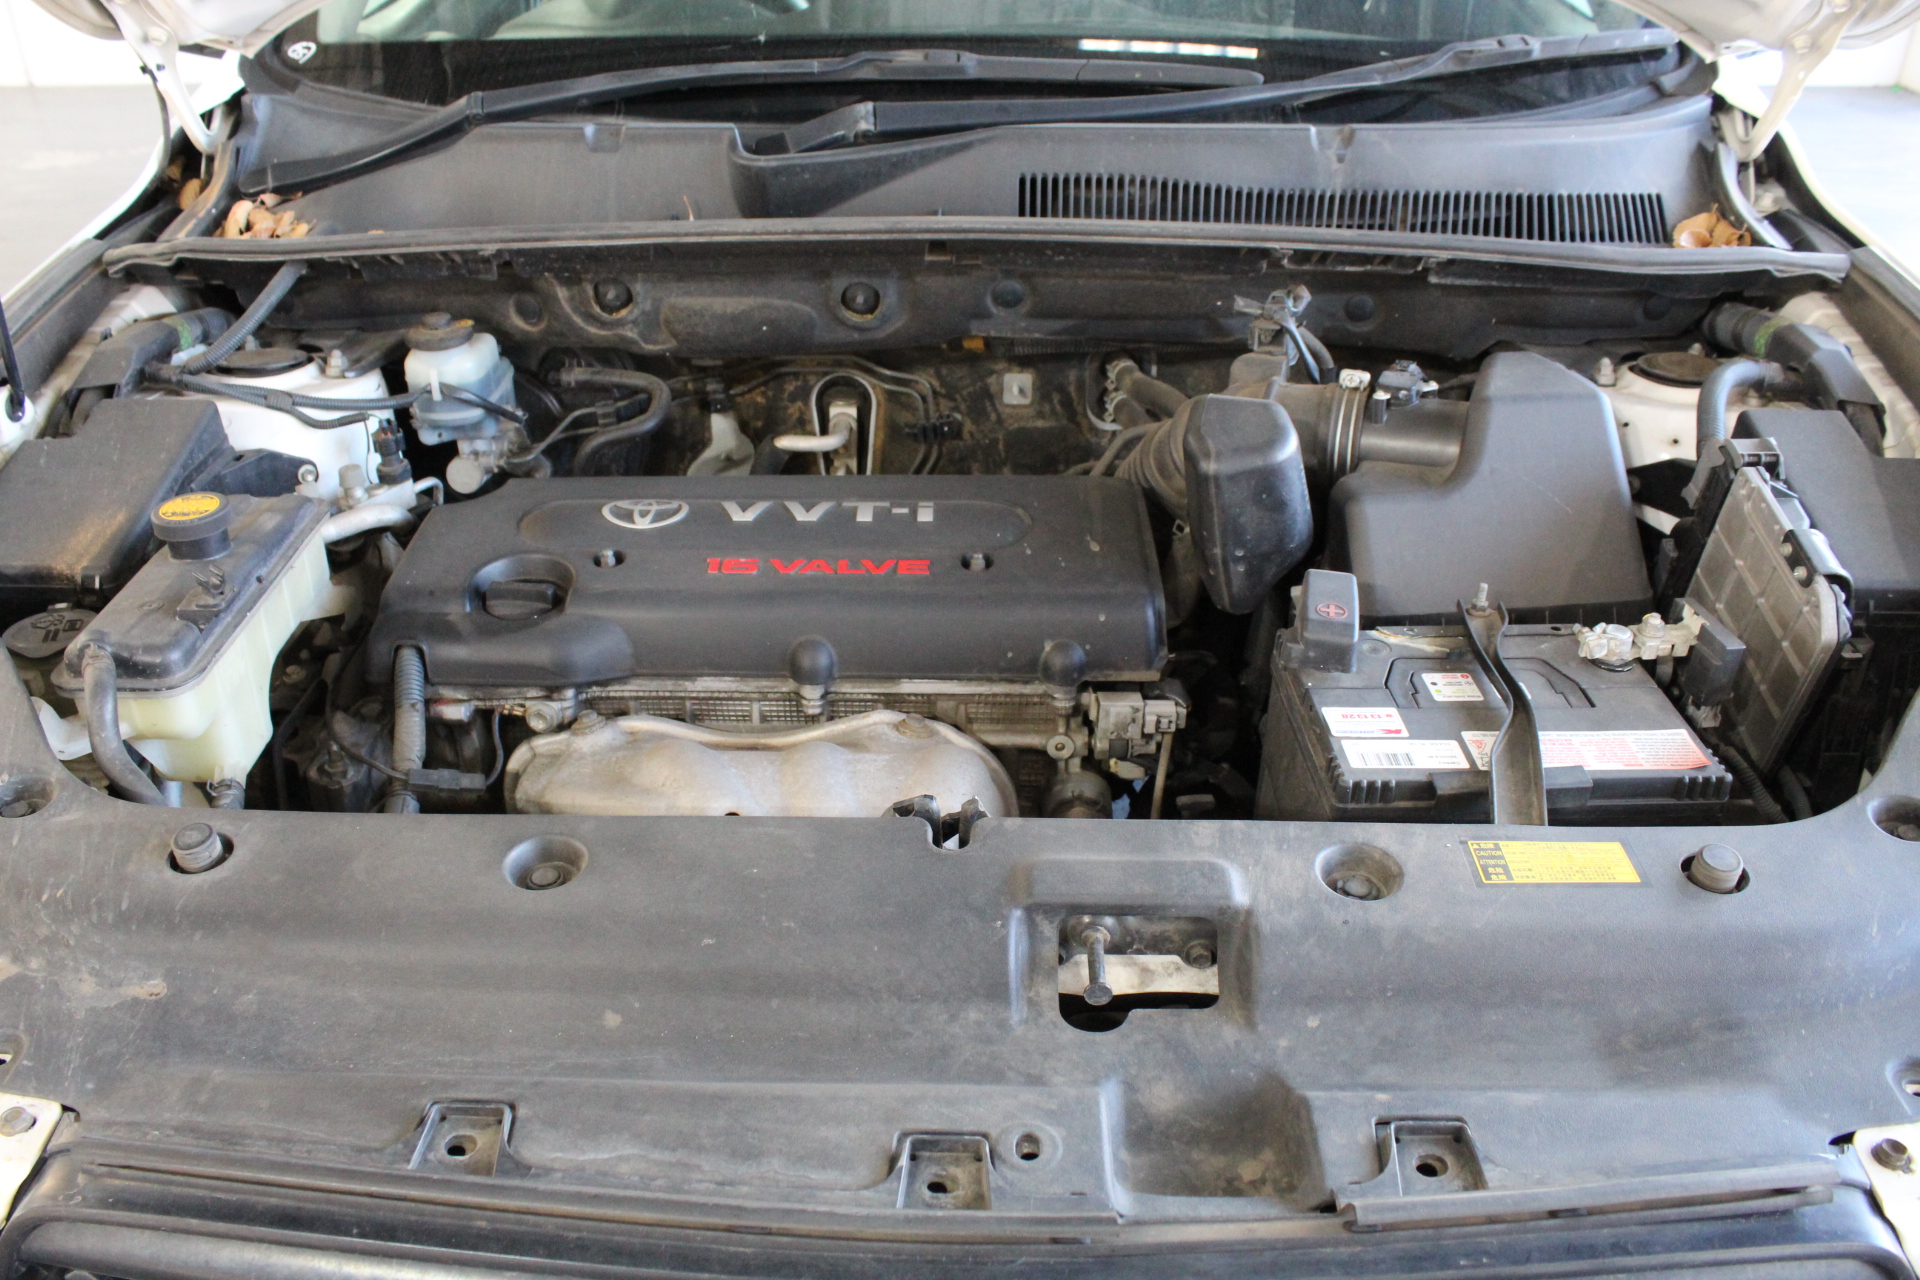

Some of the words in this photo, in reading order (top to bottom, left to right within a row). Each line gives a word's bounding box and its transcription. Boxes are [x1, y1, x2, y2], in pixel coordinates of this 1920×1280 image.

[720, 501, 934, 522] VVT-i
[706, 557, 760, 574] 16
[769, 558, 931, 575] VALVE
